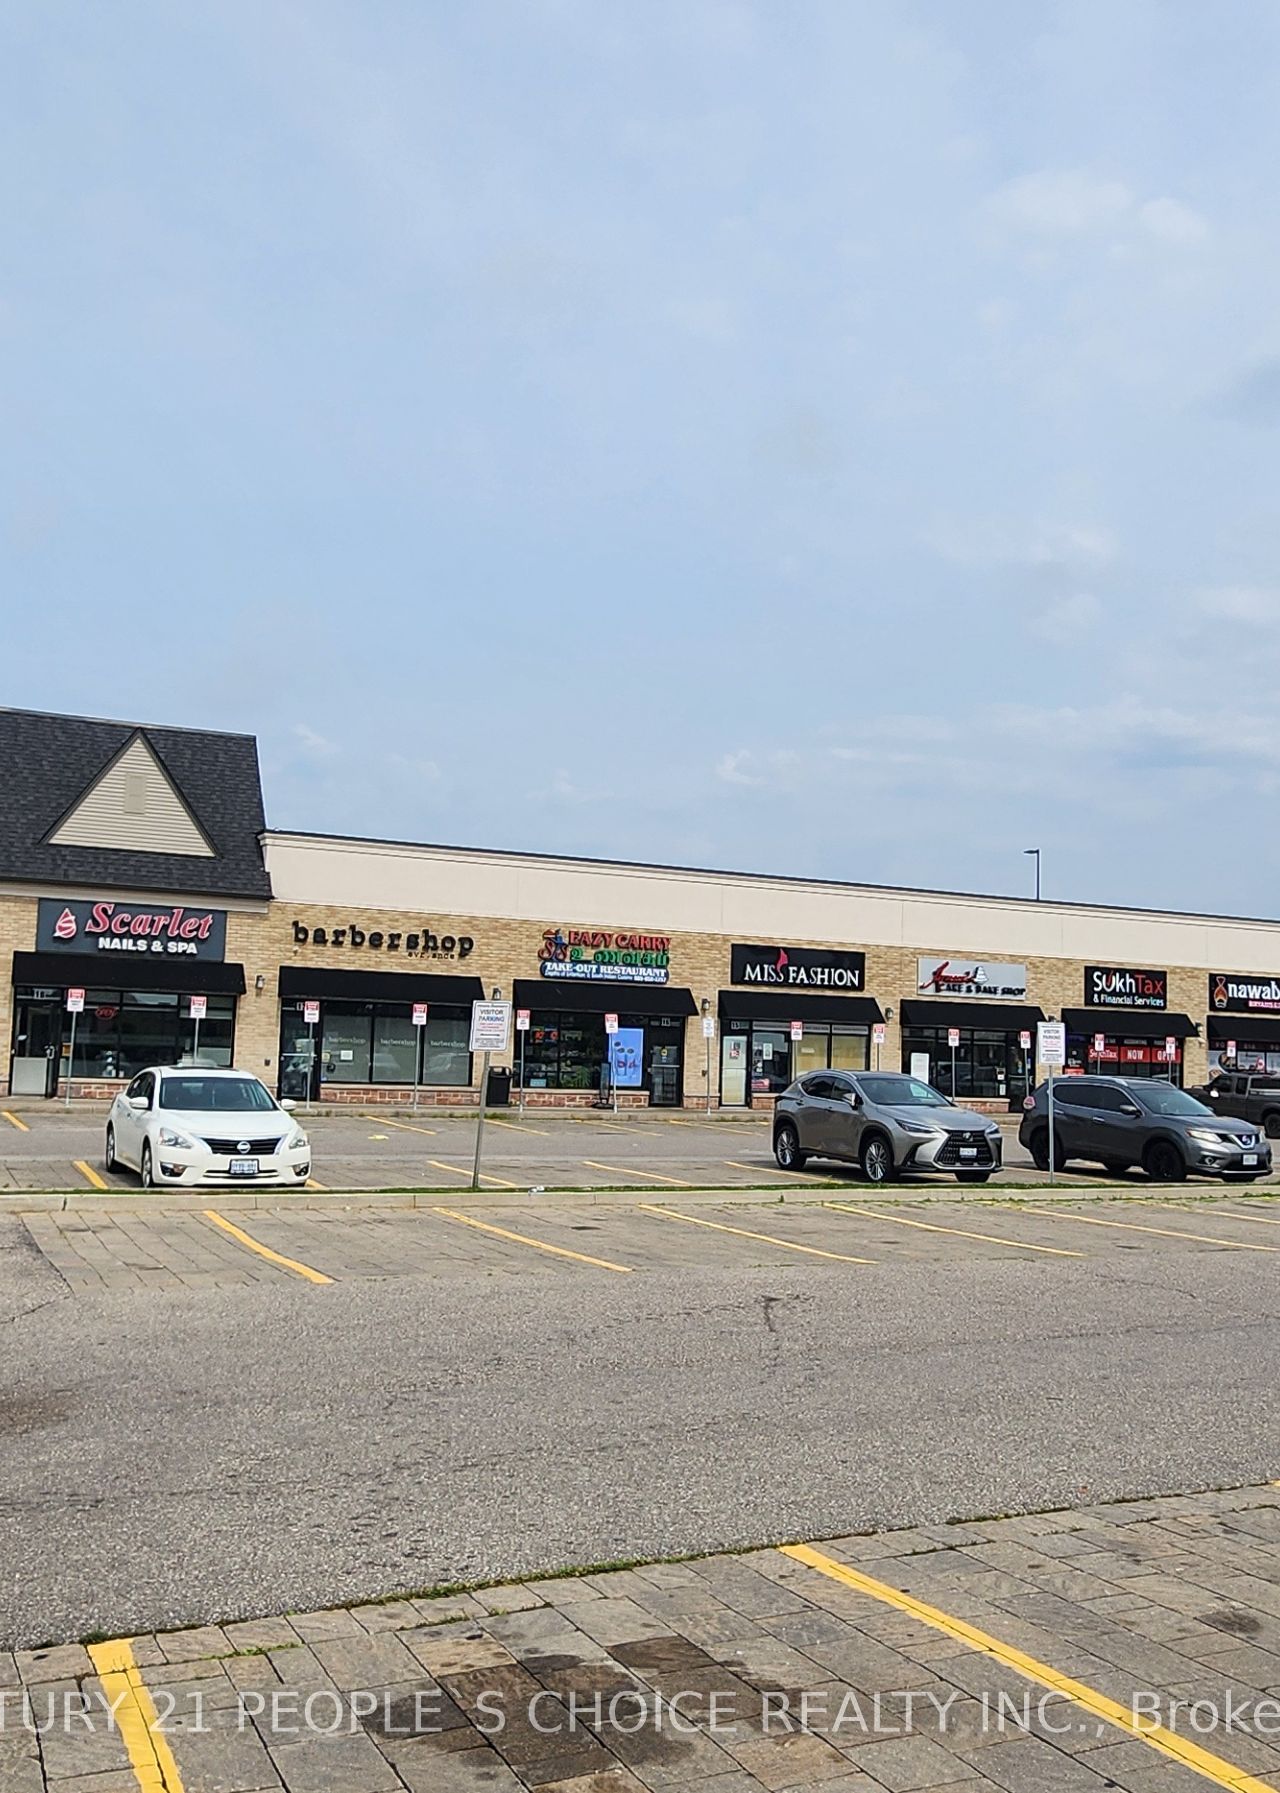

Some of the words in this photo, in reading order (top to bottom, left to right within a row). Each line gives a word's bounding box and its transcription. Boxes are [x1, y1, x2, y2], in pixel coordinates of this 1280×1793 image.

[85, 902, 213, 939] Scarlet
[98, 936, 148, 951] NAILS
[151, 940, 164, 952] &
[167, 942, 198, 954] SPA
[292, 920, 475, 959] barbershop
[615, 933, 671, 951] CARRY
[545, 962, 598, 973] TAKE-OUT
[600, 965, 666, 978] RESTAURANT
[744, 963, 784, 982] MISS
[788, 966, 859, 987] FASHION
[1227, 981, 1280, 1000] nawab
[1093, 993, 1099, 1003] &
[1101, 994, 1132, 1004] Financial
[1134, 996, 1164, 1007] Services
[380, 1038, 416, 1046] barbershop
[1127, 1049, 1144, 1060] NOW
